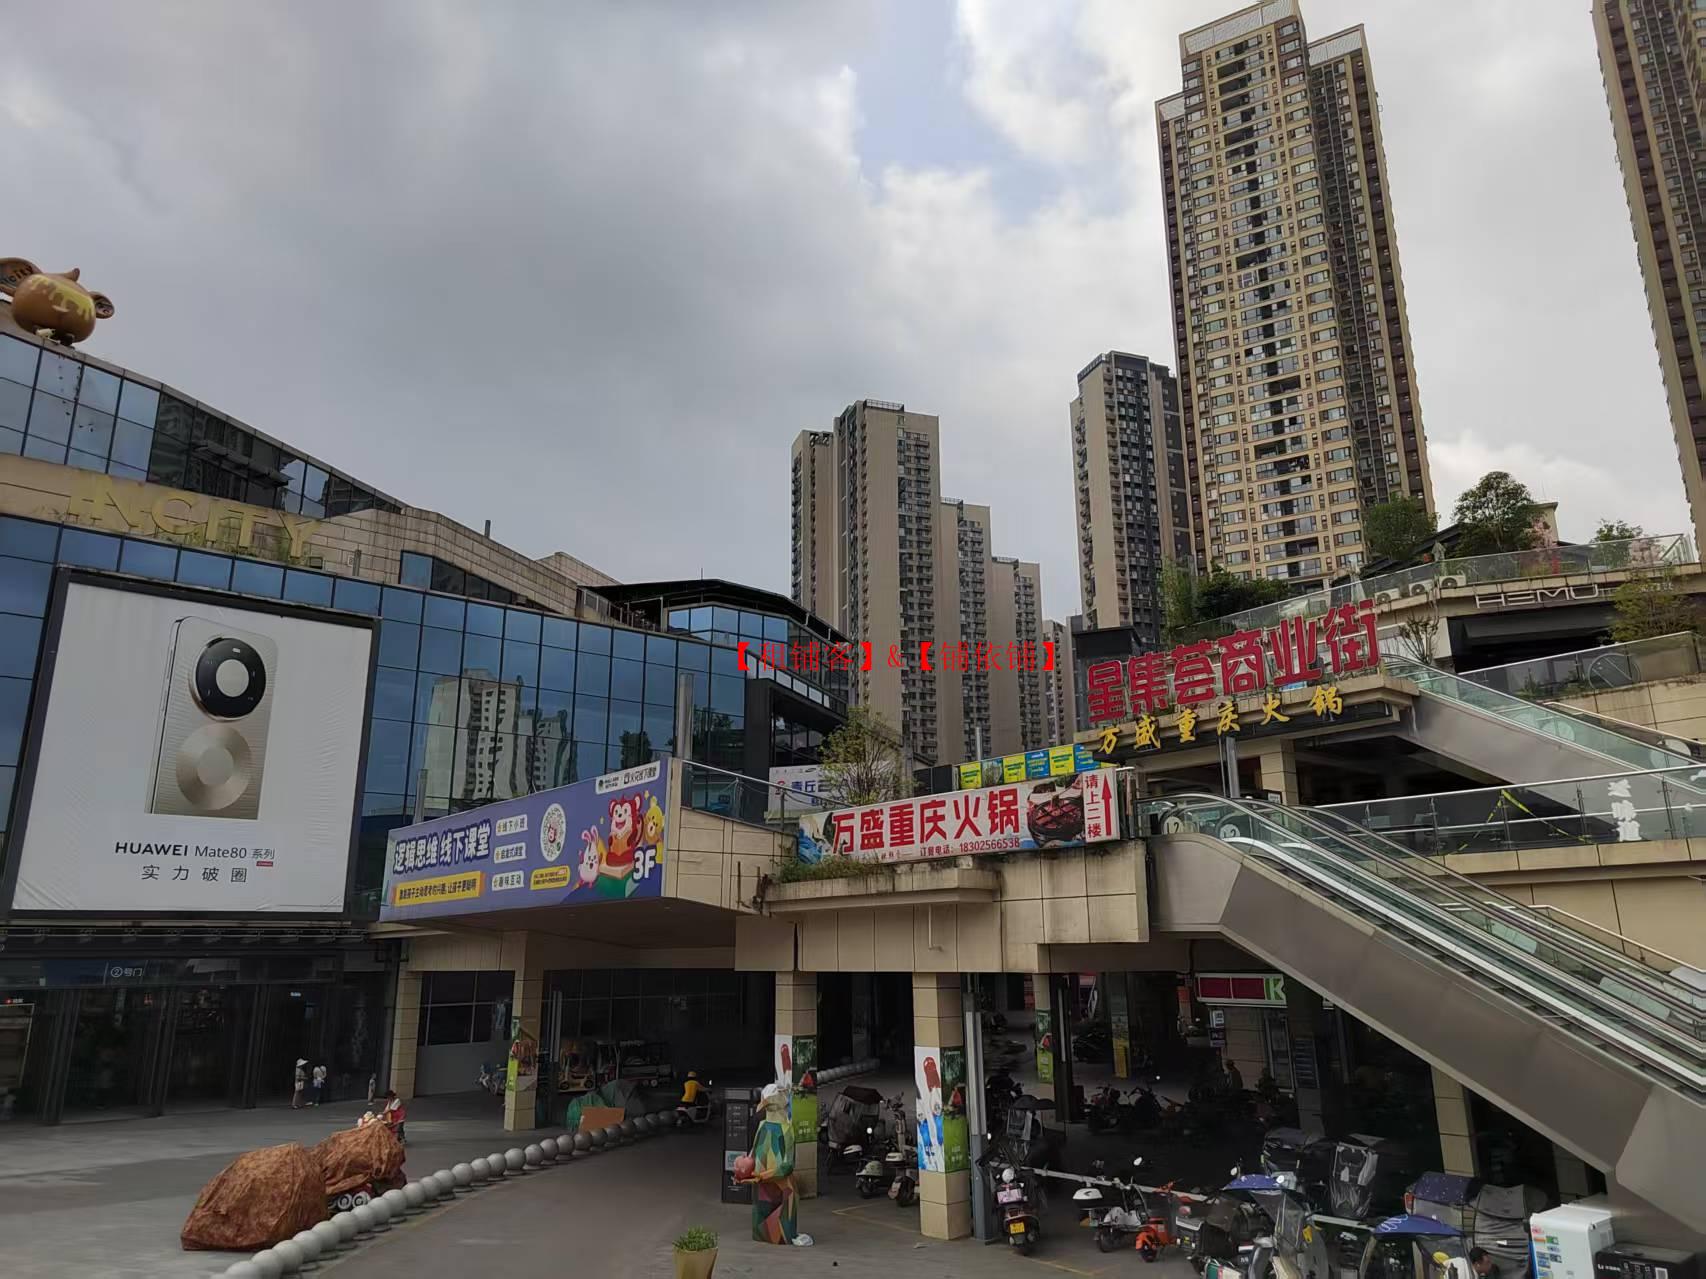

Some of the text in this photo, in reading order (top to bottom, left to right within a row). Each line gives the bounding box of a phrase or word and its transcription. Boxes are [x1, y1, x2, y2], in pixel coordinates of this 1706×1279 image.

[1099, 686, 1344, 754] 万盛重庆火锅
[832, 787, 1020, 855] 万盛重庆火锅
[1085, 773, 1103, 839] 请上二楼
[115, 842, 276, 860] HUAWEI Mate80 系列
[394, 822, 491, 872] 逻辑思维 线下课堂
[633, 848, 657, 880] 3F
[959, 837, 1020, 853] 18302566538
[141, 865, 248, 883] 实力破圈
